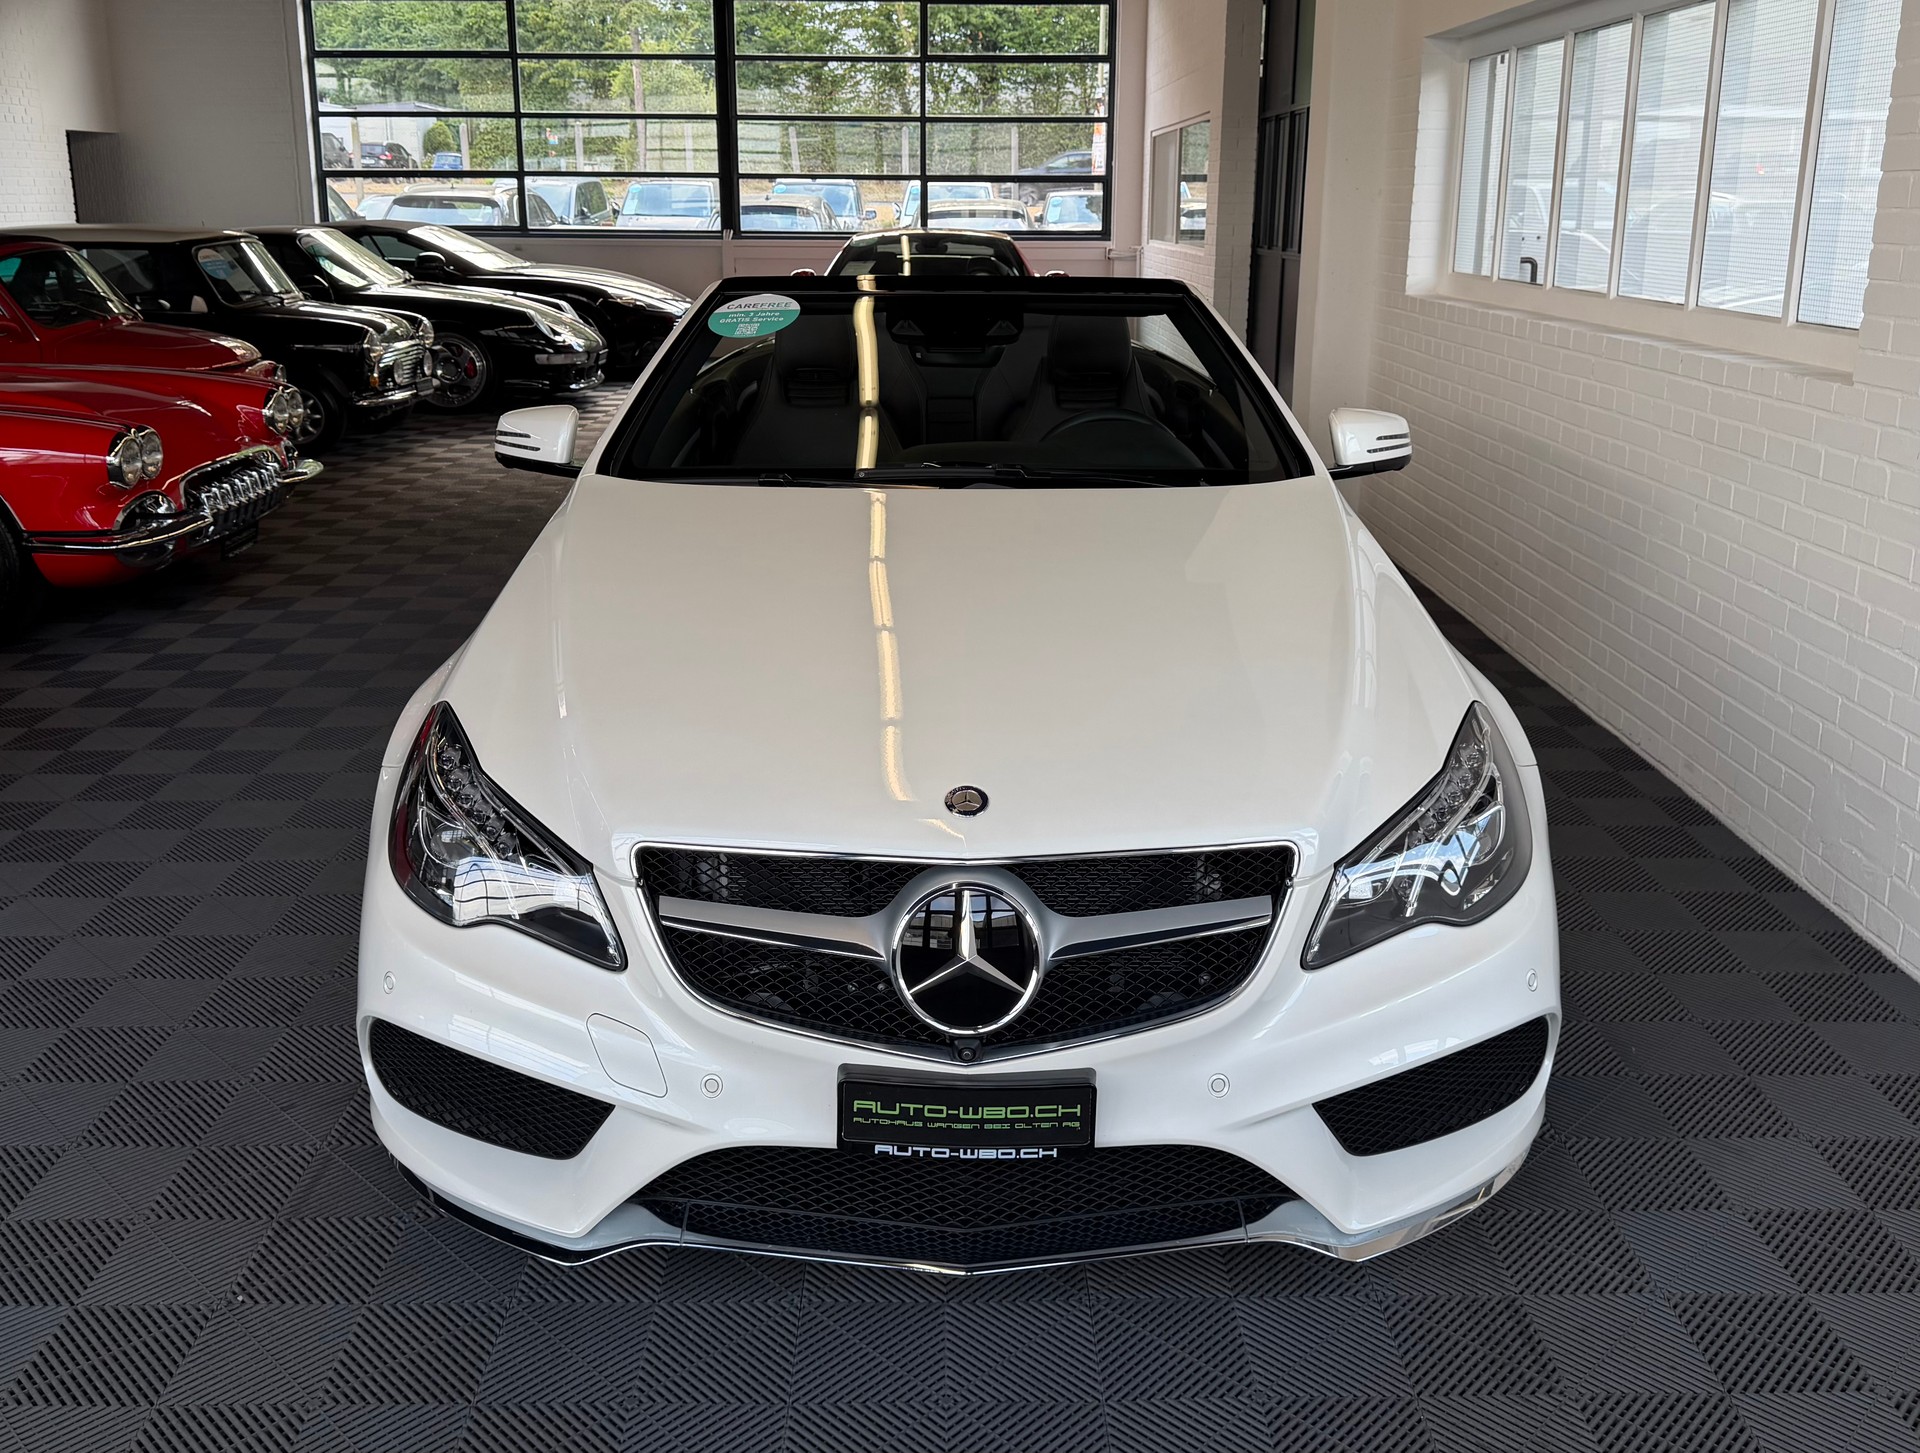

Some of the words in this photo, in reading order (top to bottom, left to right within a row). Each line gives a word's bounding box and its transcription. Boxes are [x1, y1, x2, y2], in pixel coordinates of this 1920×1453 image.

[727, 302, 792, 310] CAREFREE
[853, 1100, 1081, 1118] AUTO-WBO.CH
[853, 1118, 923, 1127] AUTOHAUS
[874, 1144, 1058, 1159] AUTO-WBO.CH
